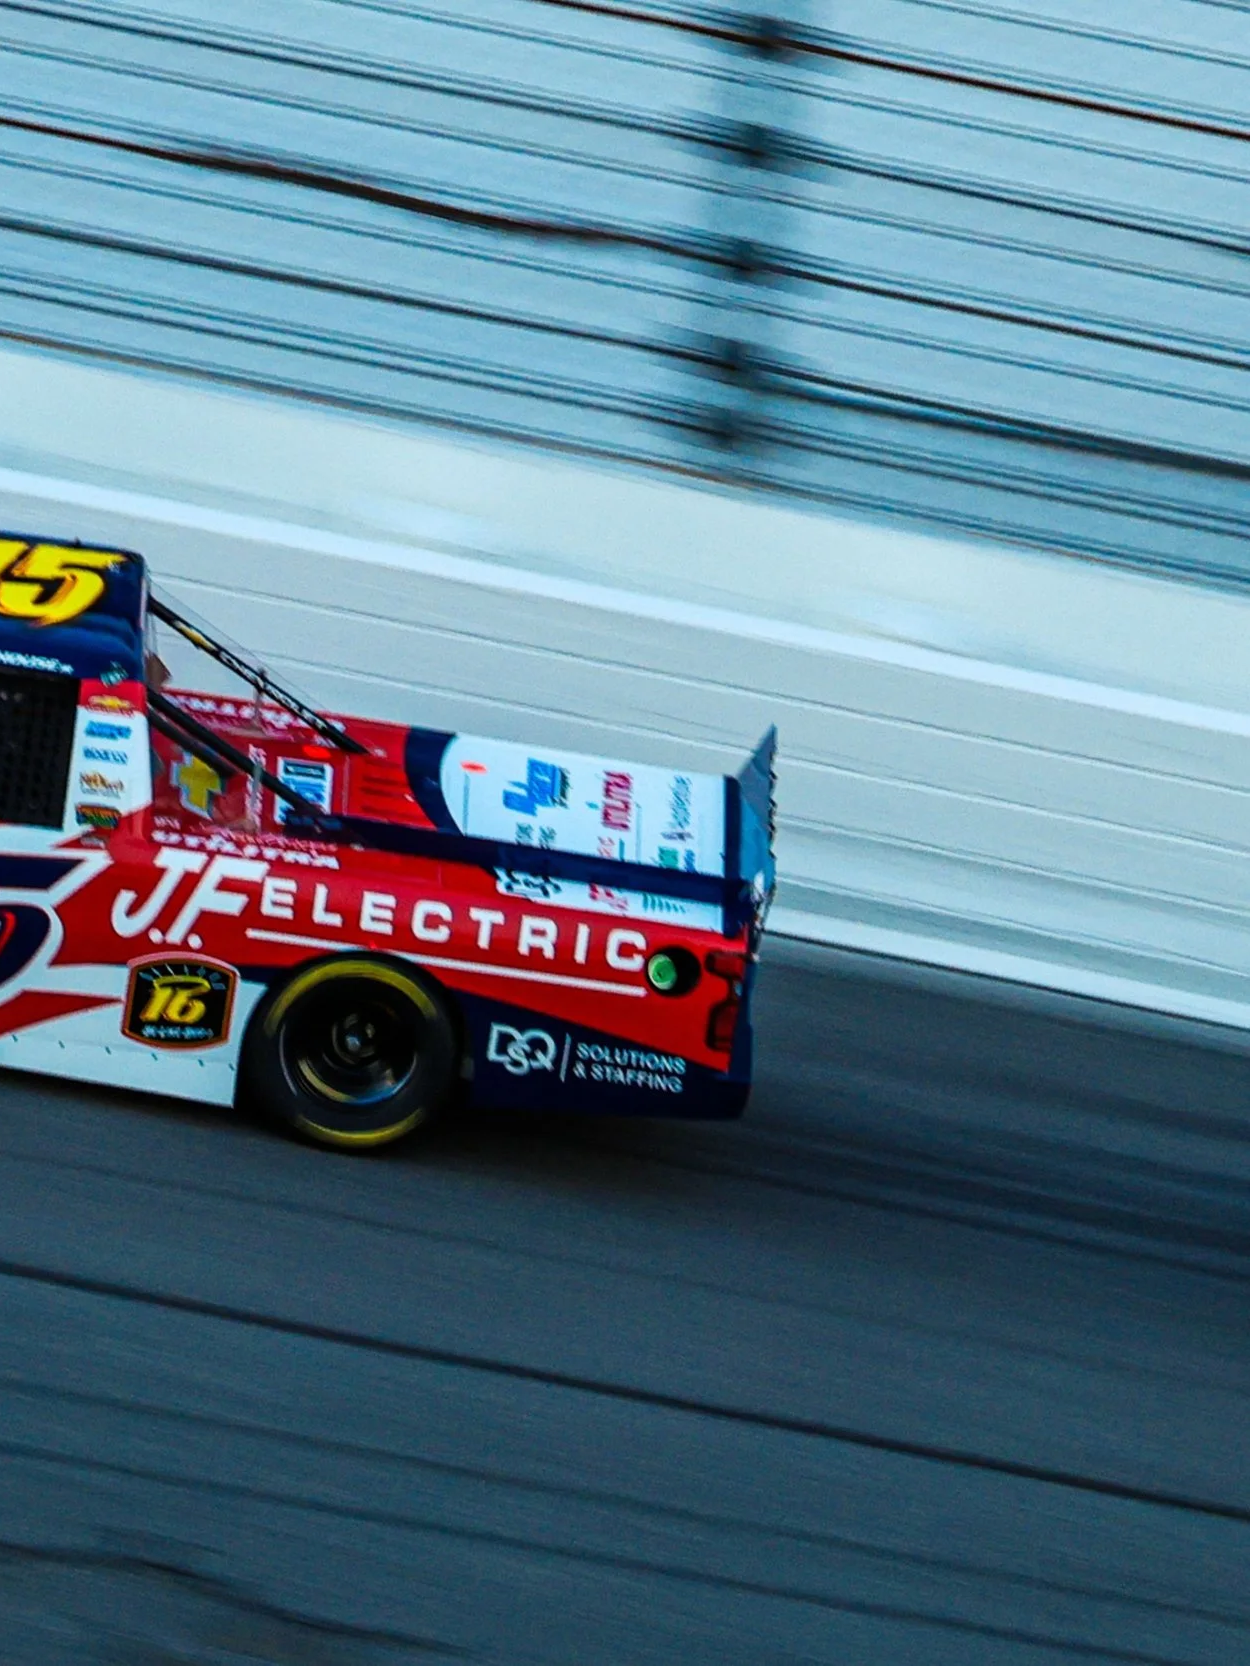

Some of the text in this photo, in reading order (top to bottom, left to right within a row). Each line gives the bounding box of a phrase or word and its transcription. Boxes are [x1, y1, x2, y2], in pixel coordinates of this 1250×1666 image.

[111, 845, 271, 949] J.F.
[260, 879, 647, 971] ELECTRIC
[139, 976, 211, 1024] 16
[572, 1061, 684, 1093] & STAFFING
[575, 1042, 687, 1075] SOLUTIONS
